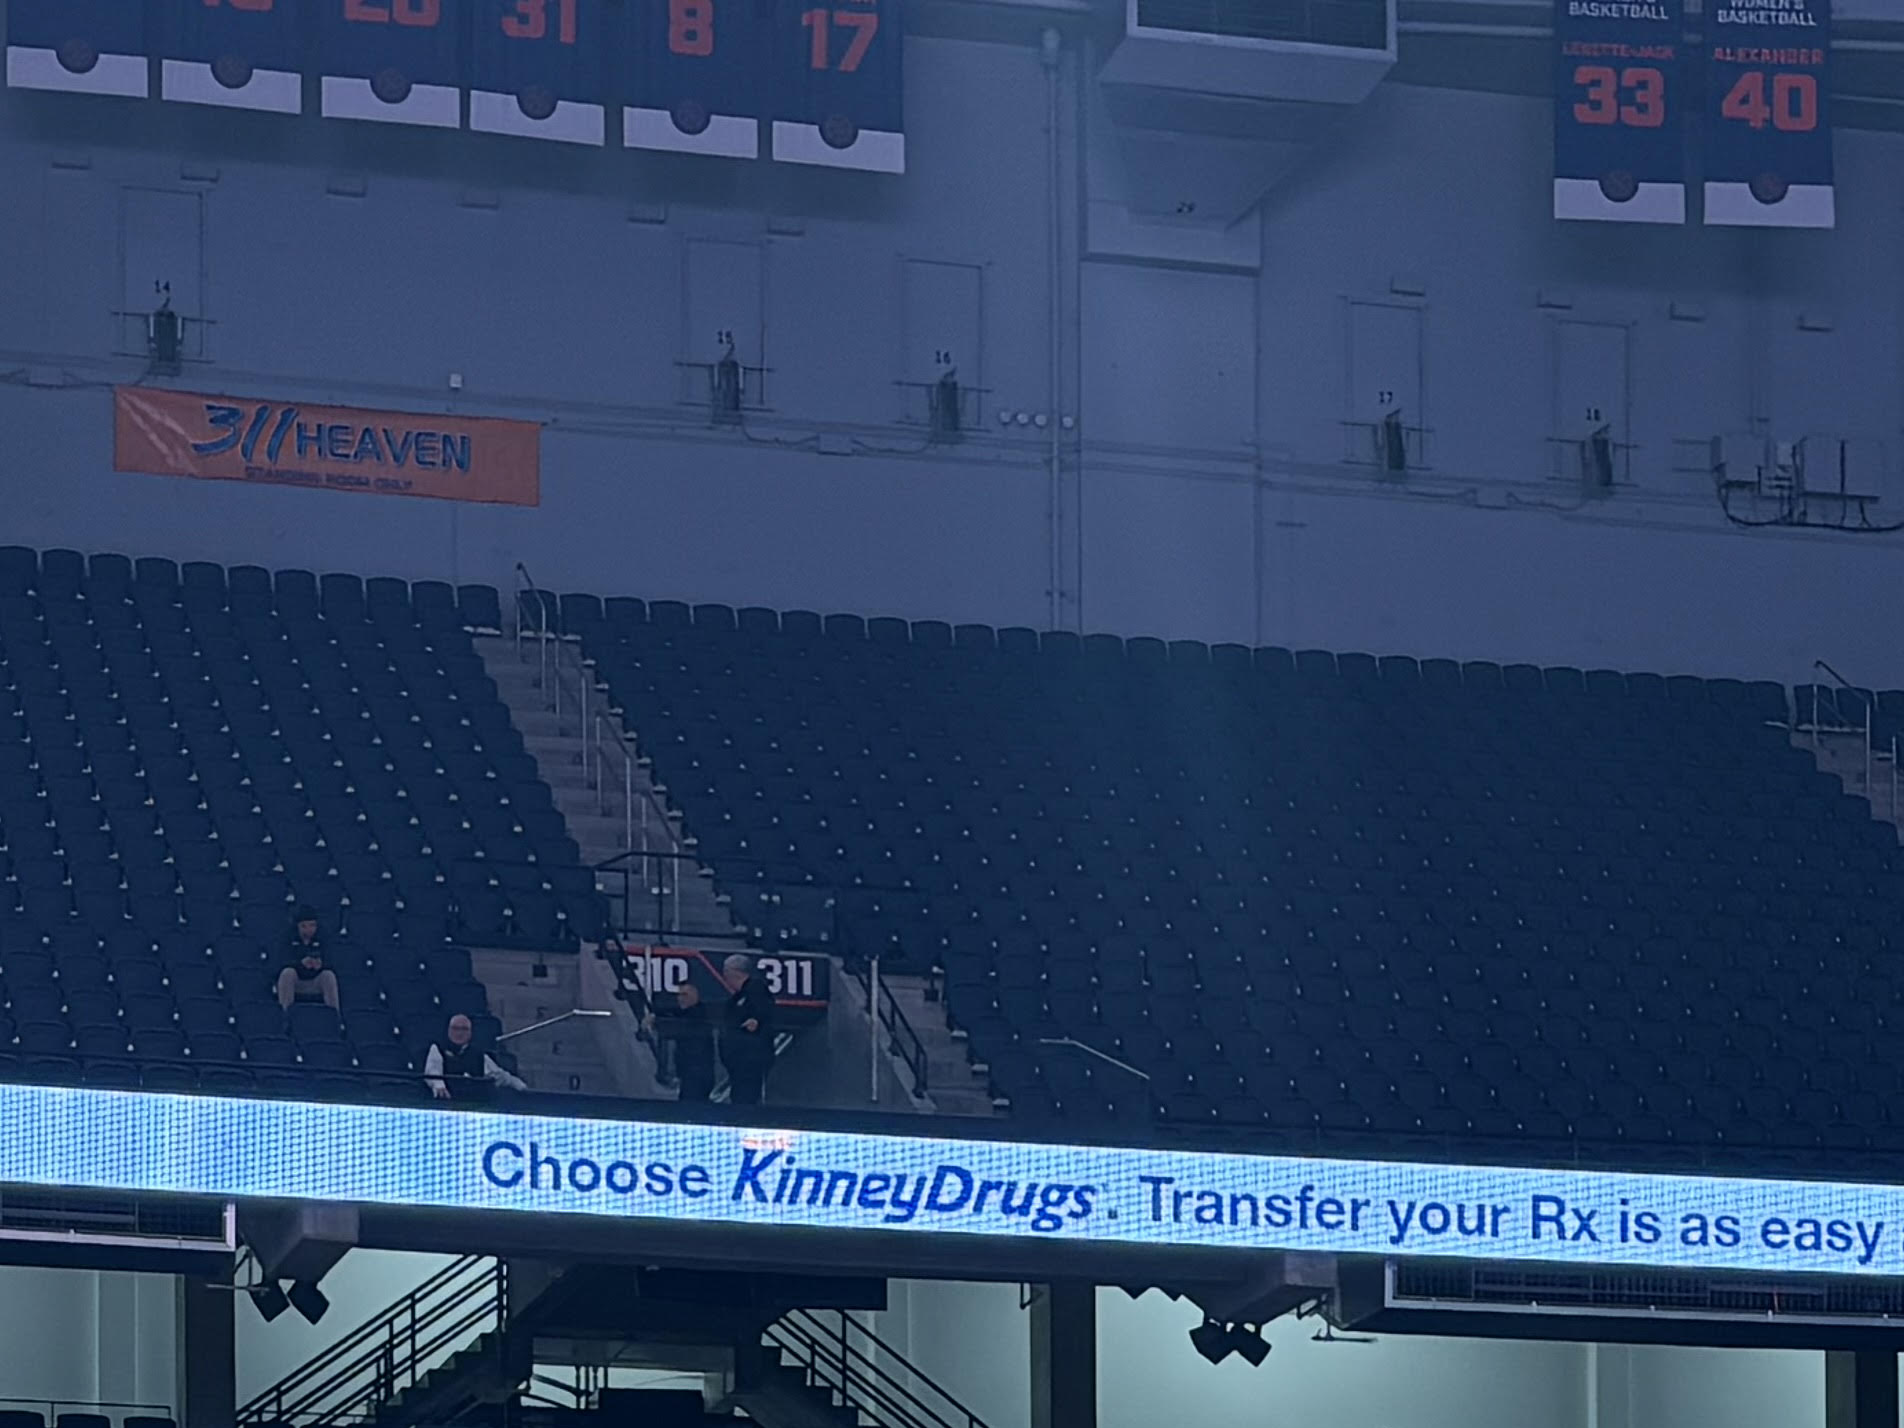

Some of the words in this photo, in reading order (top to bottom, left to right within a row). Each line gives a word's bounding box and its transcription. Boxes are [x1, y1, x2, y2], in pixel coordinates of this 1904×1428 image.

[1568, 2, 1669, 20] BASKETBALL
[1717, 9, 1817, 26] BASKETBALL
[801, 12, 879, 73] 17
[1574, 66, 1664, 127] 33
[1722, 71, 1817, 131] 40
[295, 421, 472, 474] HEAVEN
[757, 956, 813, 996] 311
[482, 1140, 711, 1199] Choose
[1148, 1173, 1371, 1230] Transfer
[1387, 1200, 1510, 1246] your
[1532, 1194, 1599, 1243] Rx
[1619, 1199, 1662, 1247] is
[1679, 1213, 1742, 1248] as
[1760, 1217, 1884, 1263] easy
